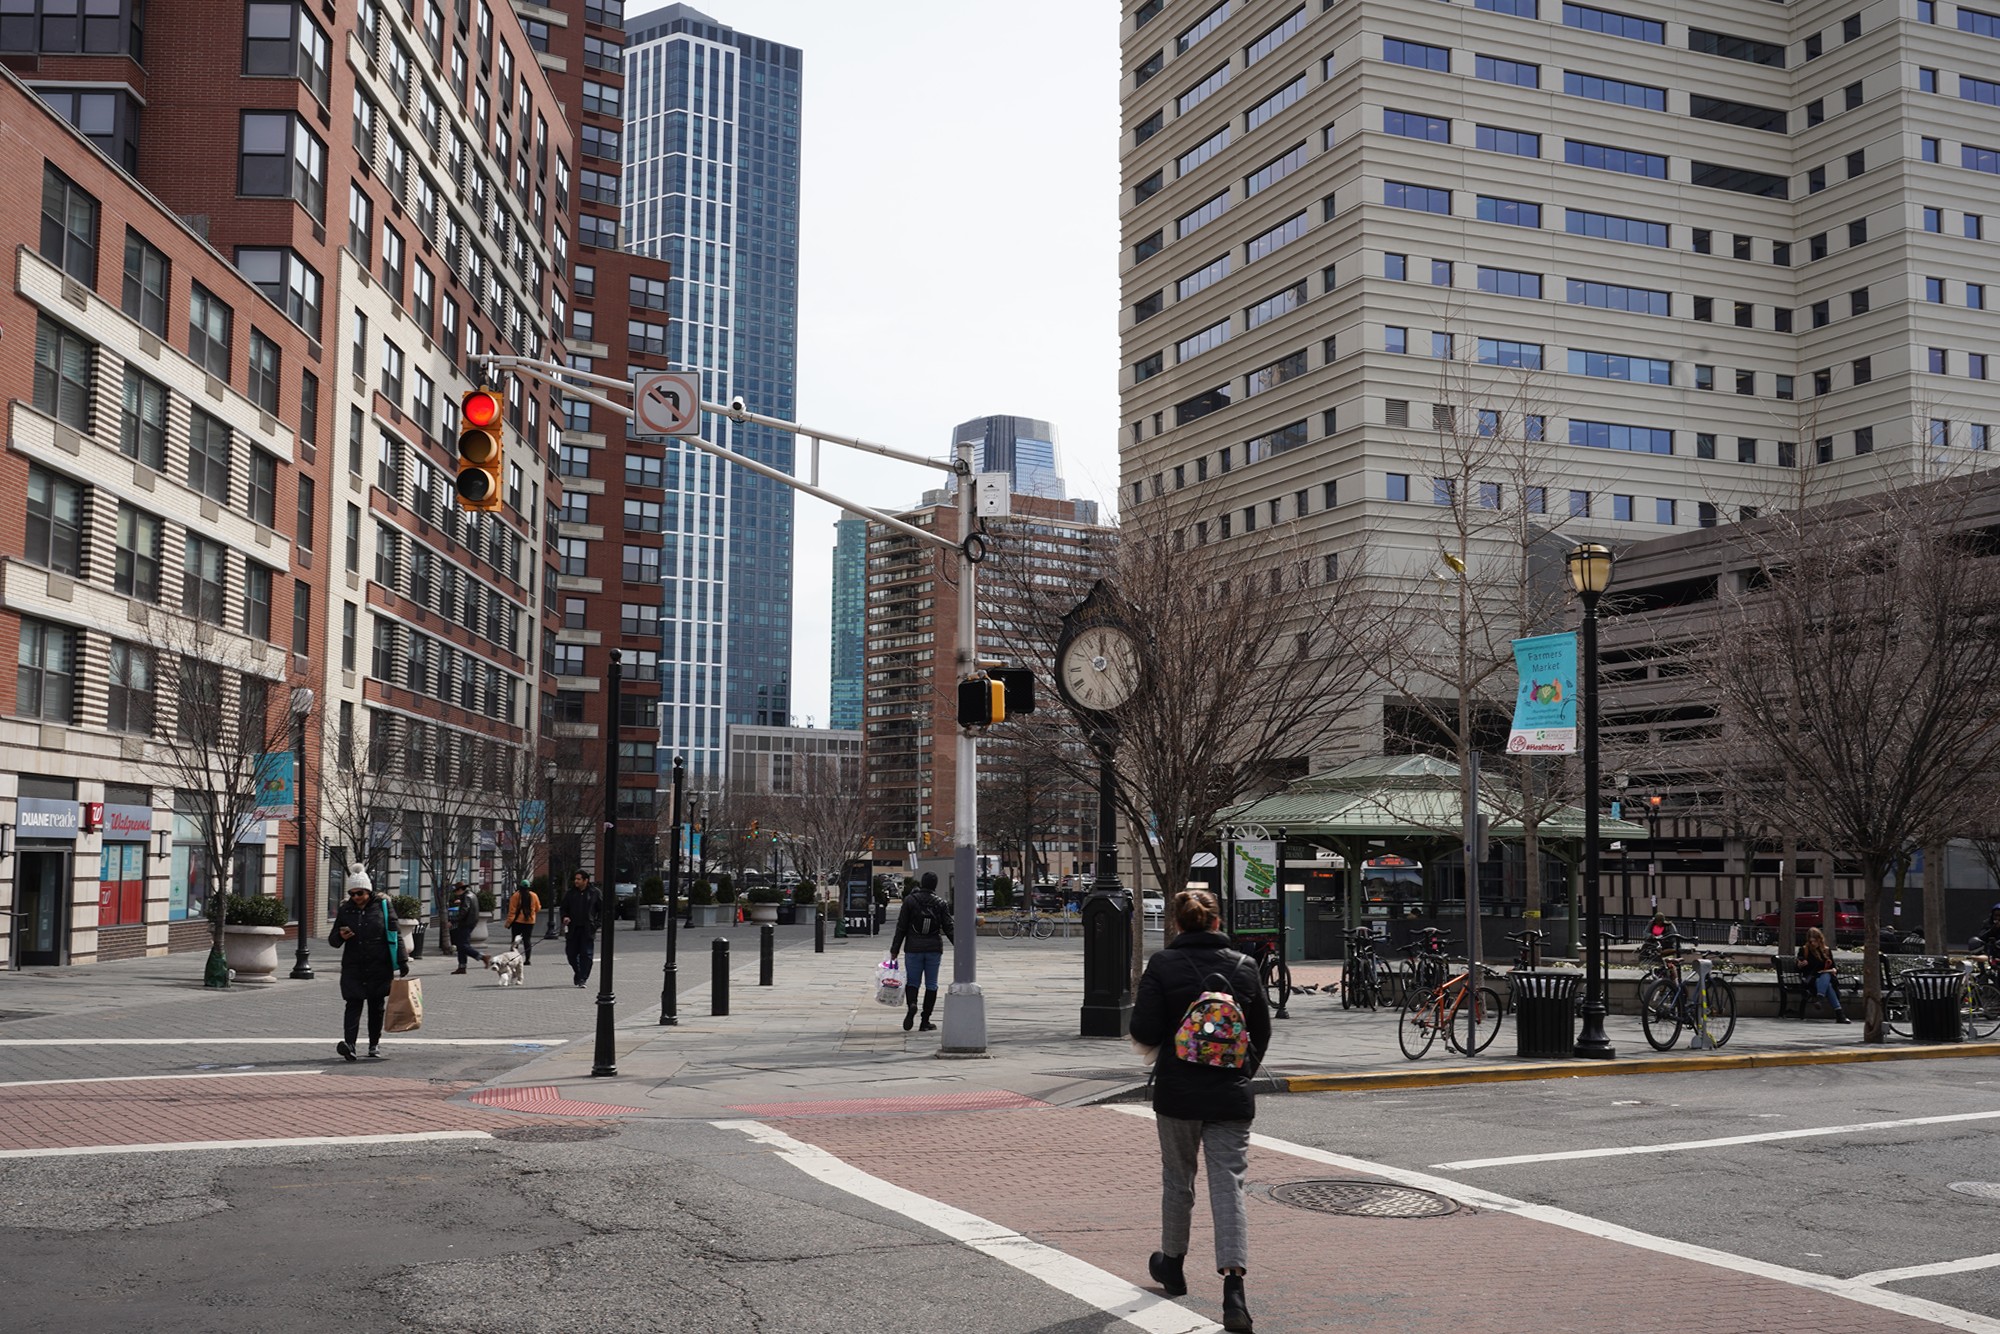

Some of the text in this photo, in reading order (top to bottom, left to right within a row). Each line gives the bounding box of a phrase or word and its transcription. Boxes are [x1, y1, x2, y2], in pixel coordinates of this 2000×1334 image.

[1528, 651, 1562, 661] Farmers
[1532, 662, 1560, 672] Market
[1526, 743, 1565, 751] #HealthierJC
[92, 806, 102, 821] W
[111, 812, 150, 836] Walgreens
